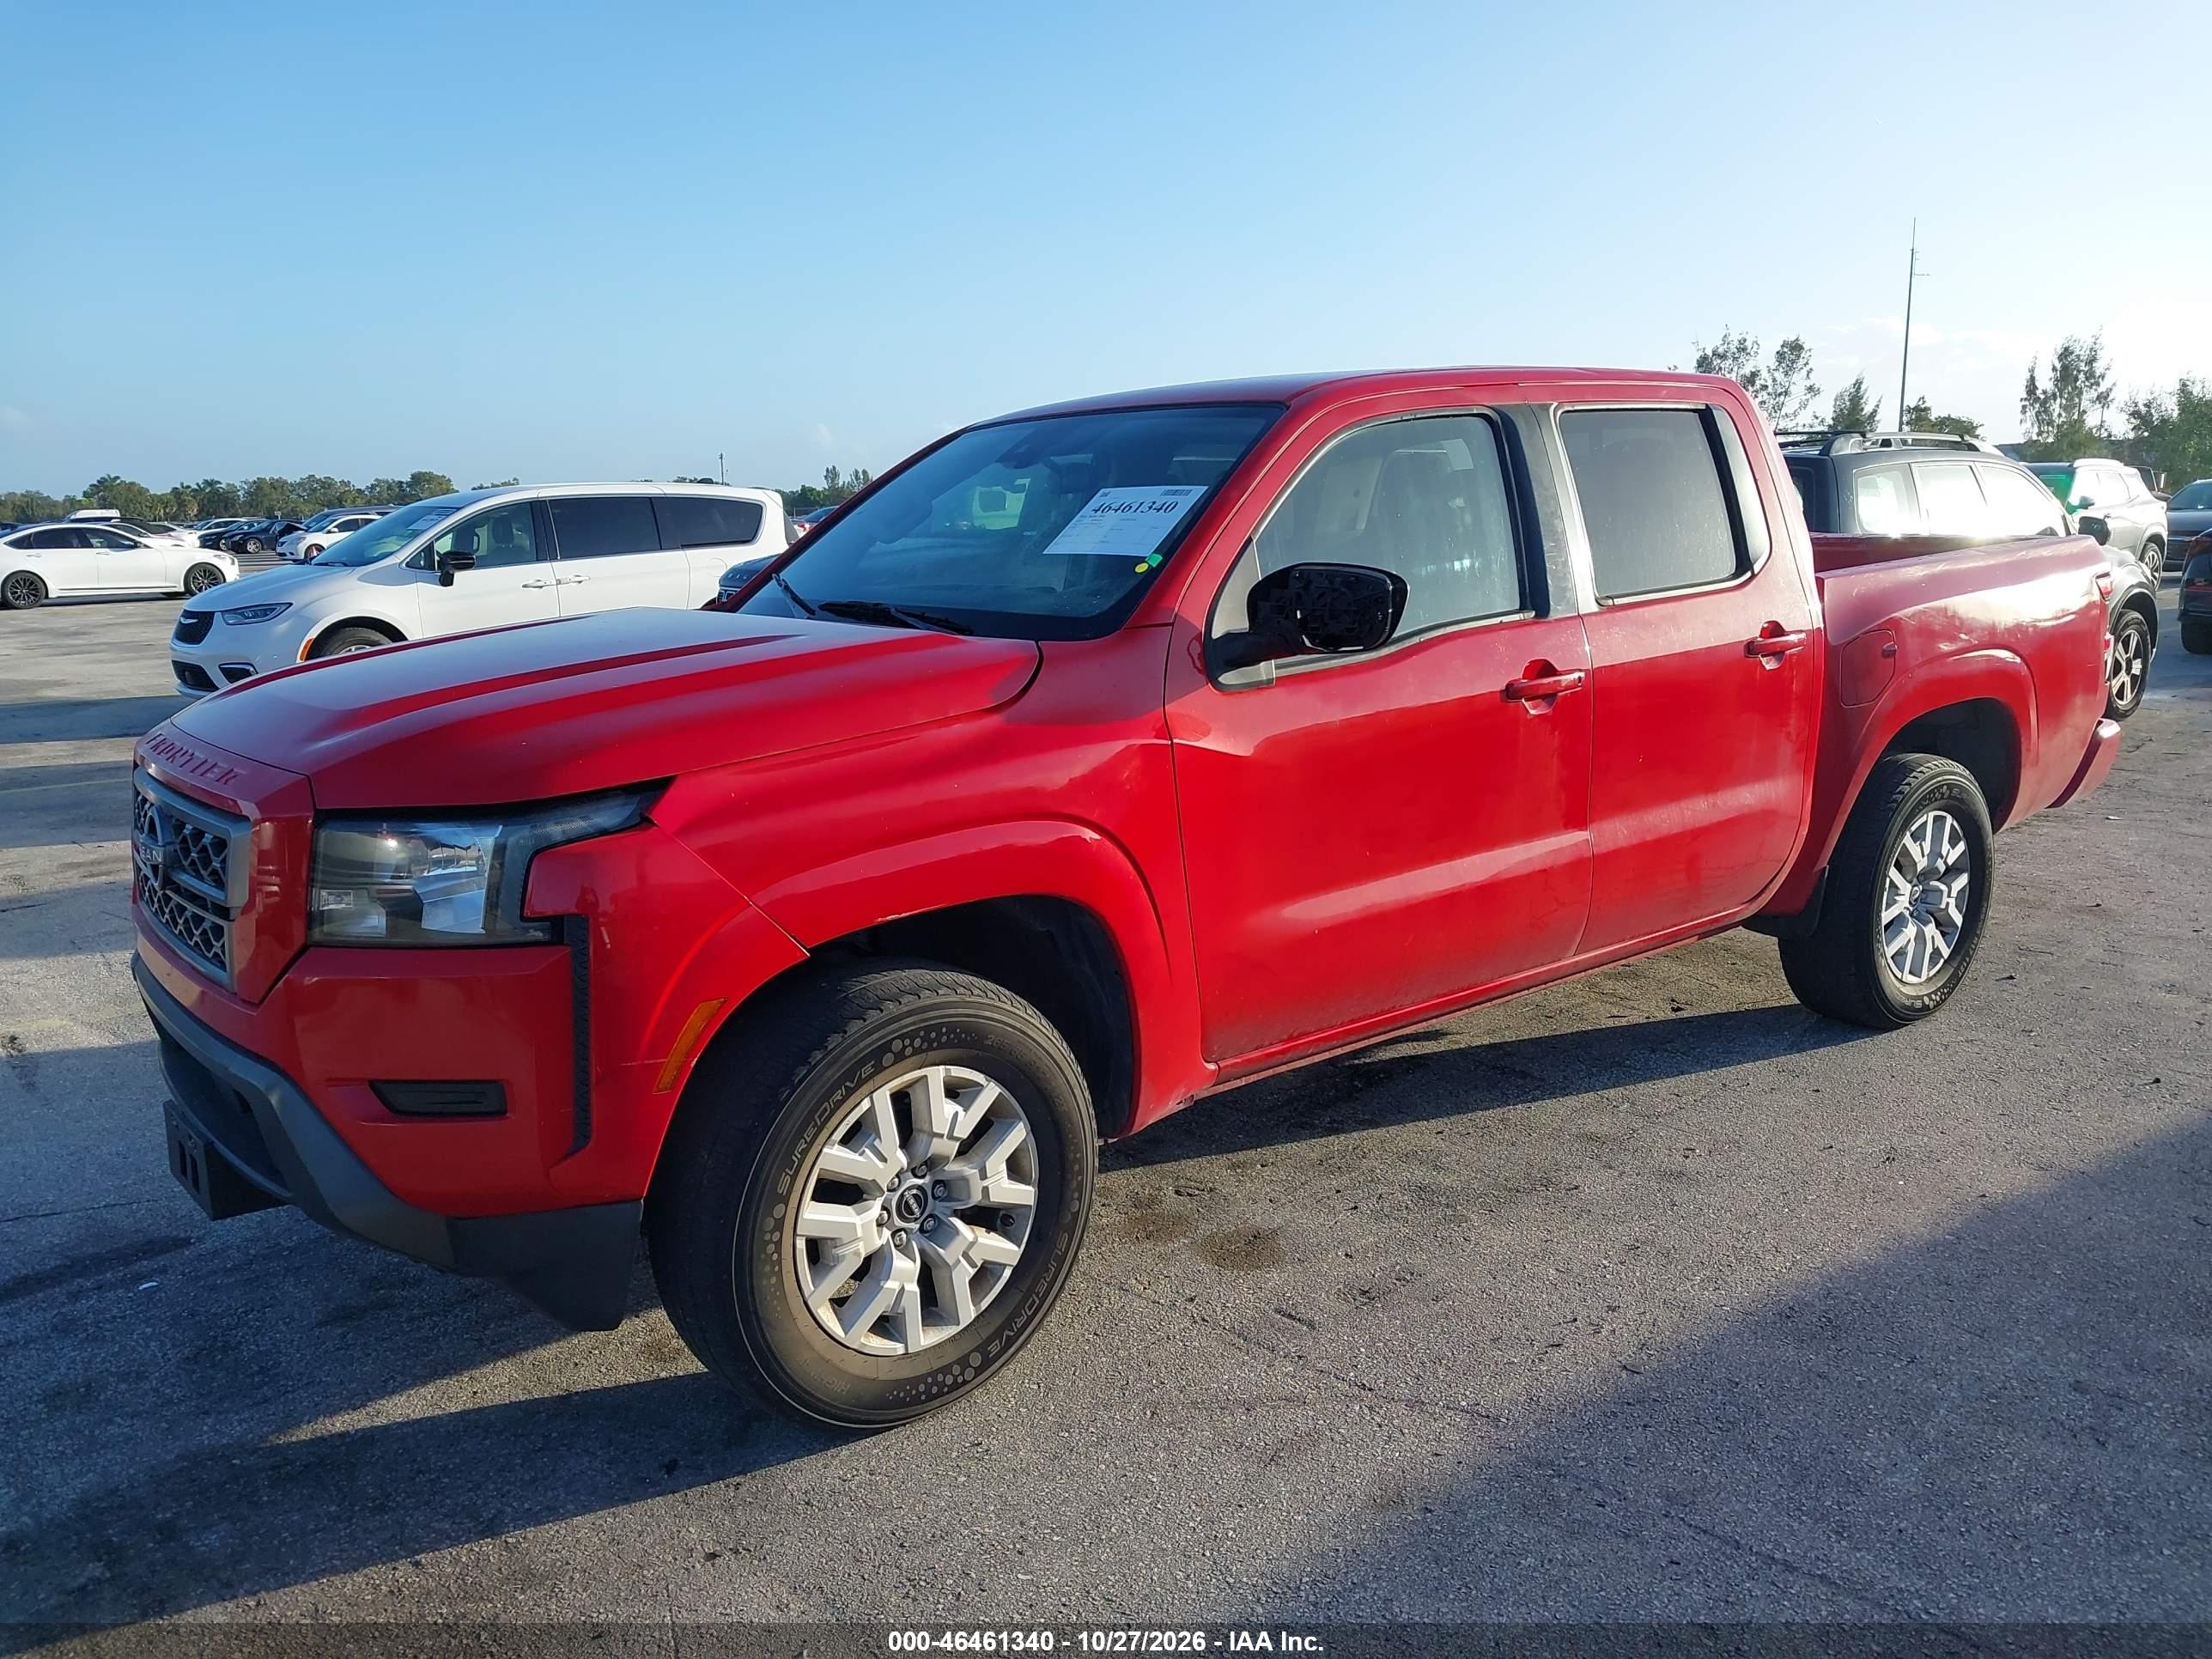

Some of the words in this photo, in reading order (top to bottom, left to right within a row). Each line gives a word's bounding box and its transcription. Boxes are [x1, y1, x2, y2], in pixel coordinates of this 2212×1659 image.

[1091, 501, 1179, 514] 46461340
[776, 1060, 876, 1196] SUREDRIVE
[988, 1231, 1069, 1358] SUREDRIVE
